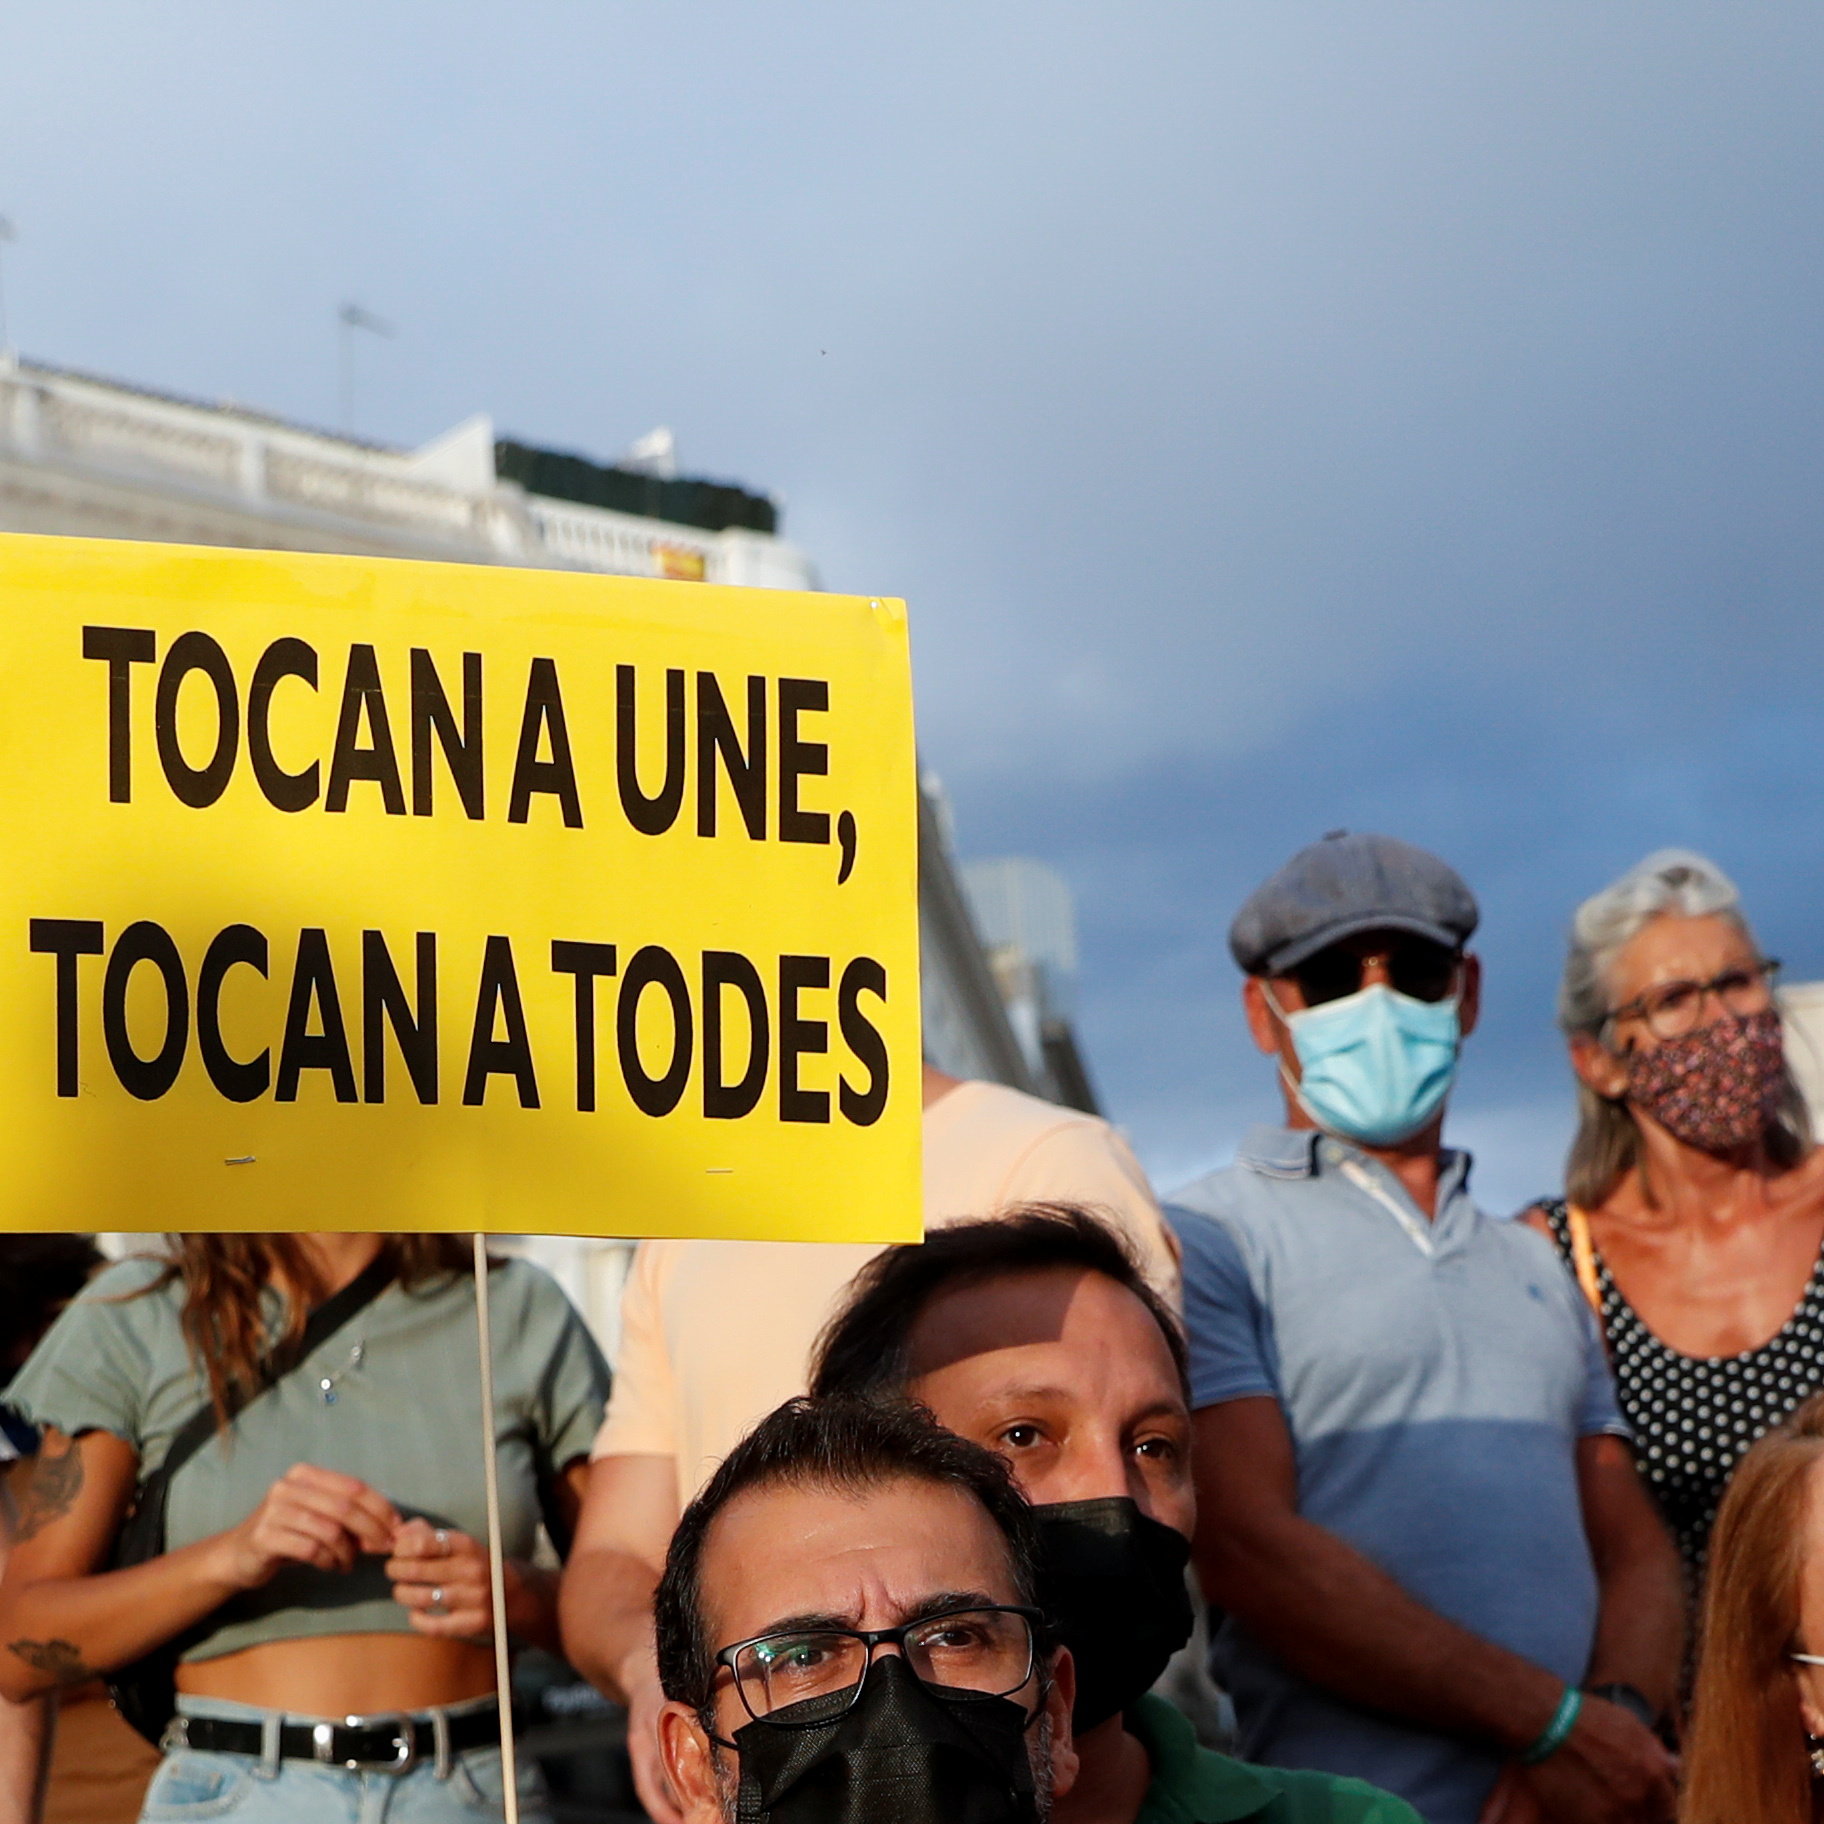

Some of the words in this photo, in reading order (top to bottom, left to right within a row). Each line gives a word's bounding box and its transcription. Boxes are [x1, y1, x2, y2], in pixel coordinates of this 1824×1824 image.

[81, 625, 486, 821] TOCAN
[507, 657, 584, 829] A
[615, 664, 857, 886] UNE,
[28, 918, 440, 1106] TOCAN
[461, 935, 541, 1110] A
[550, 939, 890, 1127] TODES
